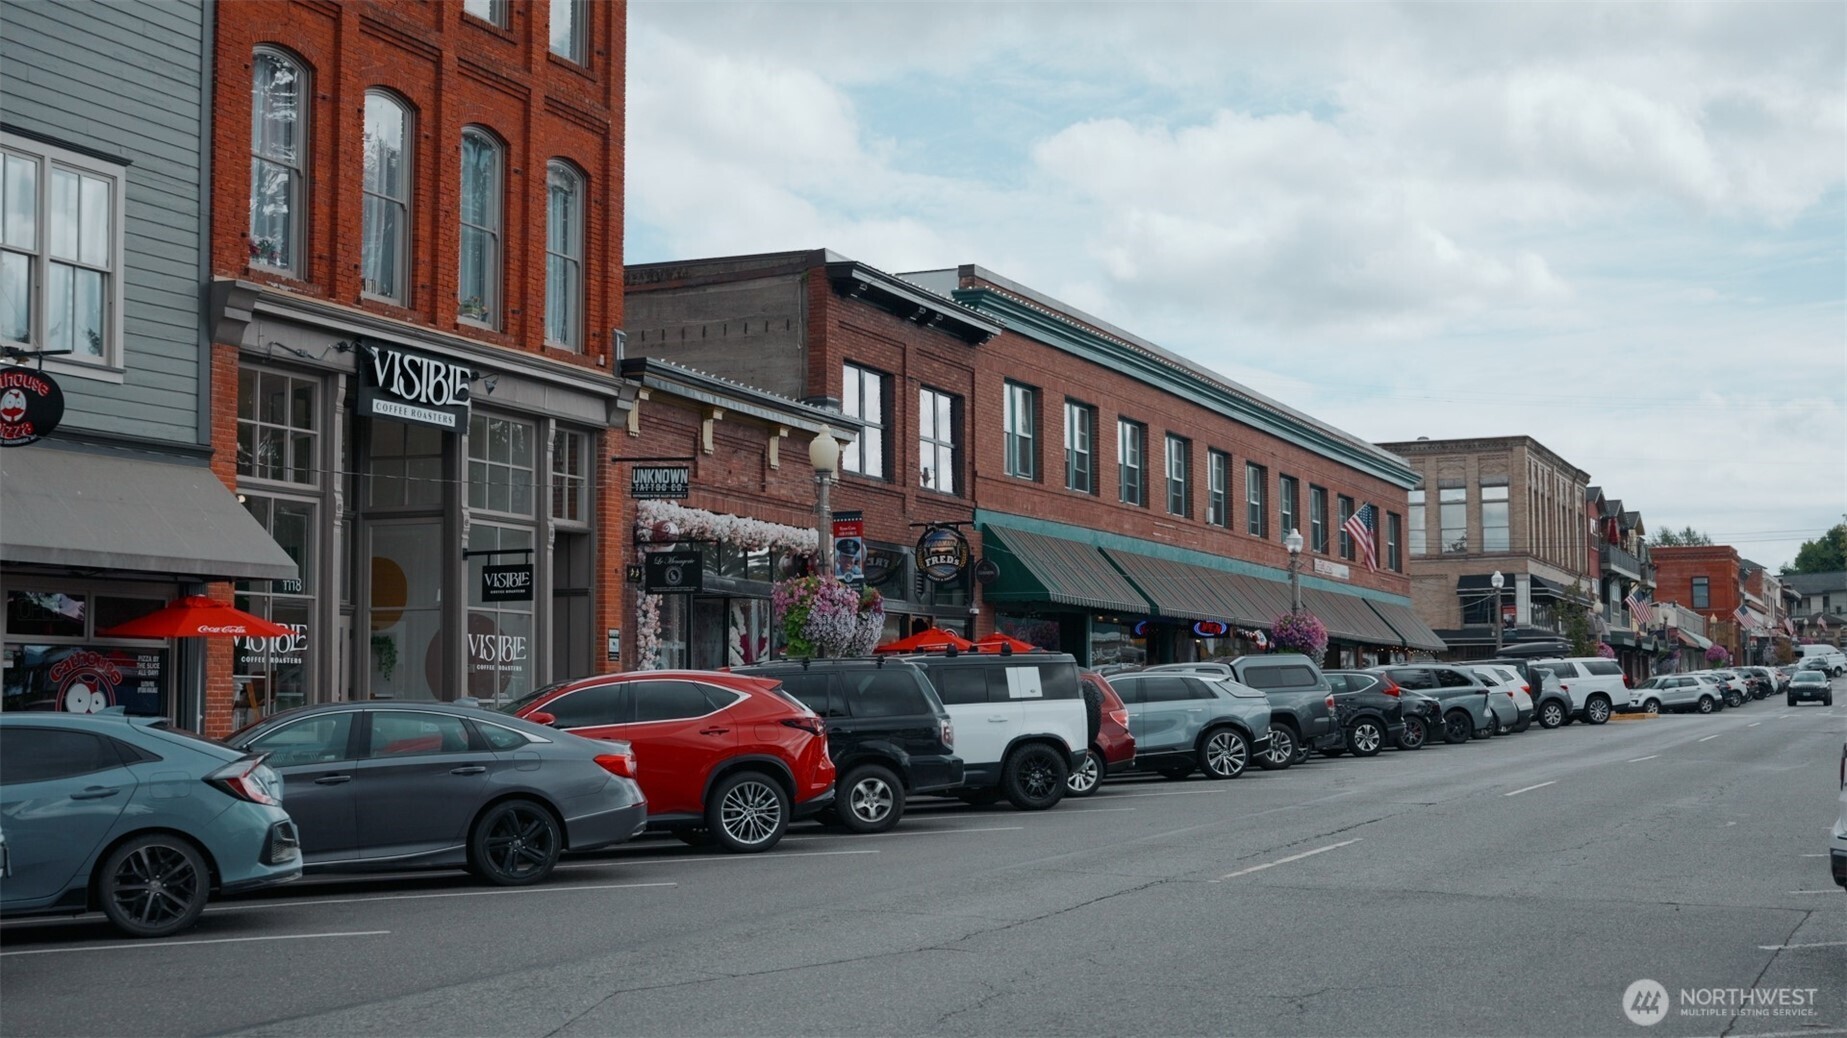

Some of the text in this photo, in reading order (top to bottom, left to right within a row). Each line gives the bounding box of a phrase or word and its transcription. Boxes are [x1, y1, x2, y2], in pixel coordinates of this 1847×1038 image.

[371, 346, 471, 406] VISIBLE
[376, 402, 453, 424] COFFEE ROASTERS
[0, 422, 34, 439] izza
[632, 469, 688, 484] UNKNOWN
[484, 572, 530, 588] VISIBLE
[198, 625, 247, 633] Coca-Cola
[468, 634, 527, 662] VISIBLE
